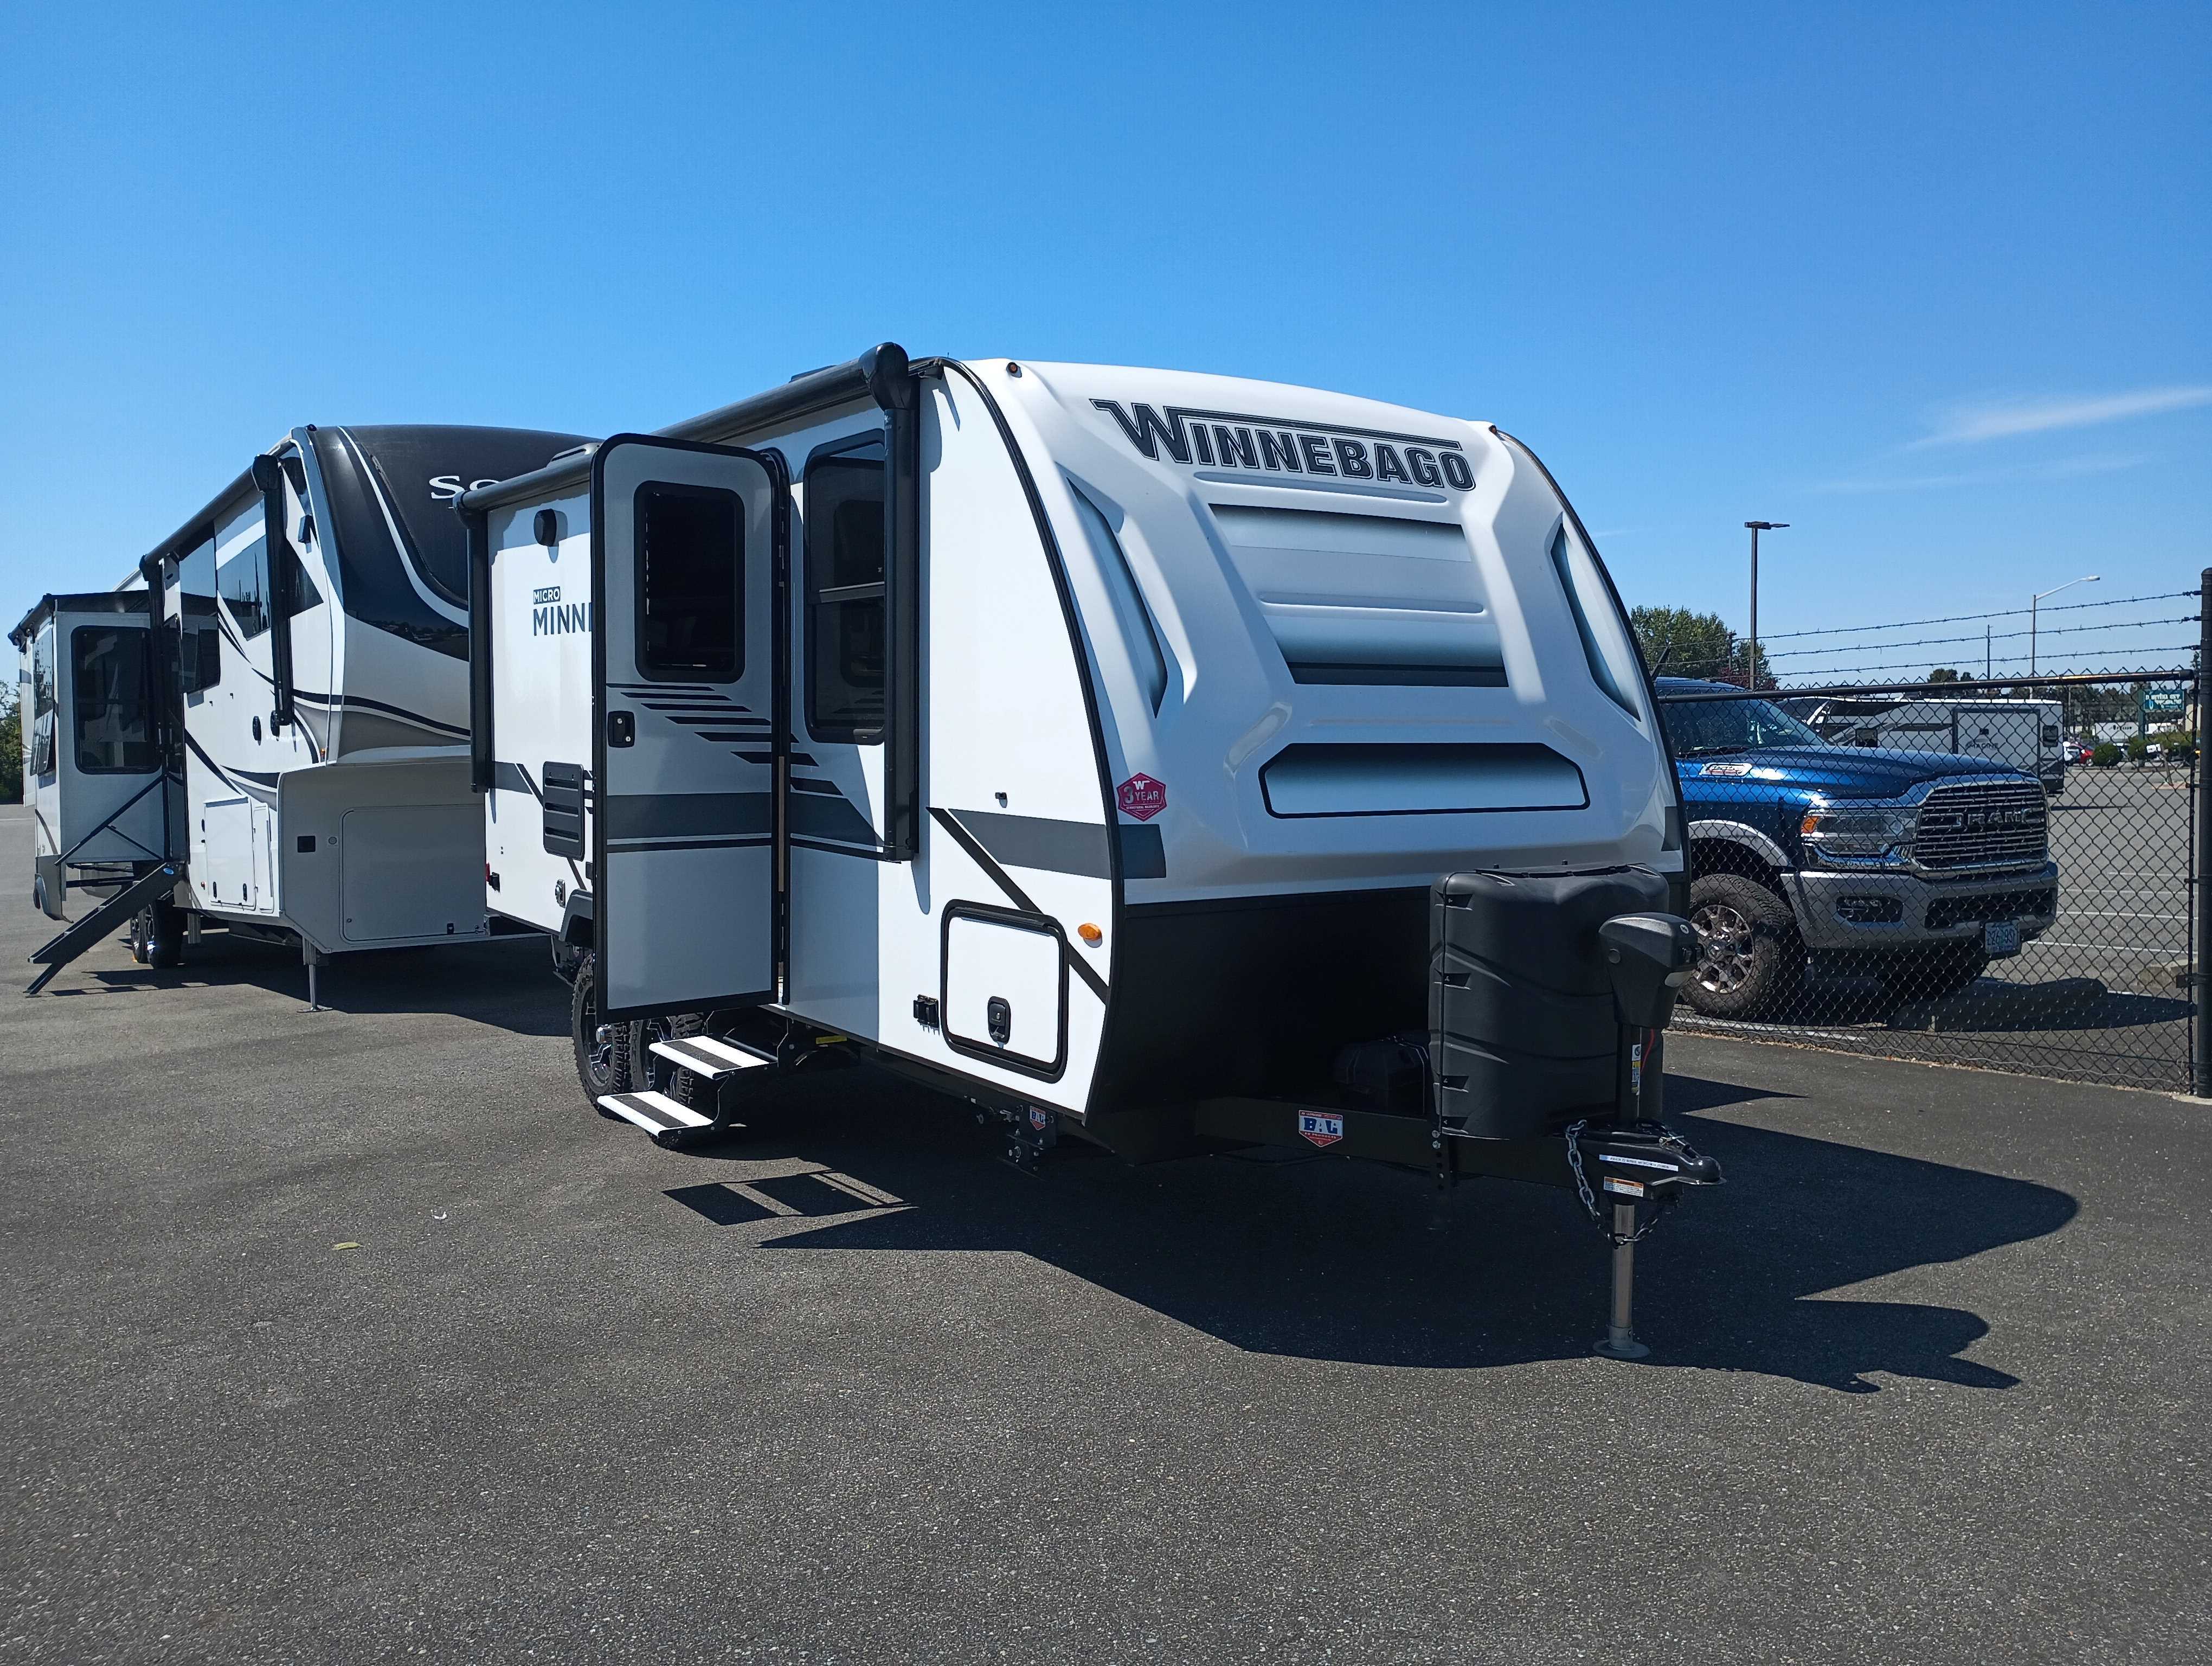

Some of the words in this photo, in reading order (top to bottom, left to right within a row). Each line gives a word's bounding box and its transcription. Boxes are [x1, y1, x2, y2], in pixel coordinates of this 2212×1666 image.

[1089, 399, 1476, 491] WINNEBAGO
[533, 588, 560, 603] MICRO
[1123, 786, 1134, 804] 3
[1135, 791, 1159, 801] YEAR
[1967, 811, 2021, 825] RAM
[1304, 1117, 1338, 1135] BAL
